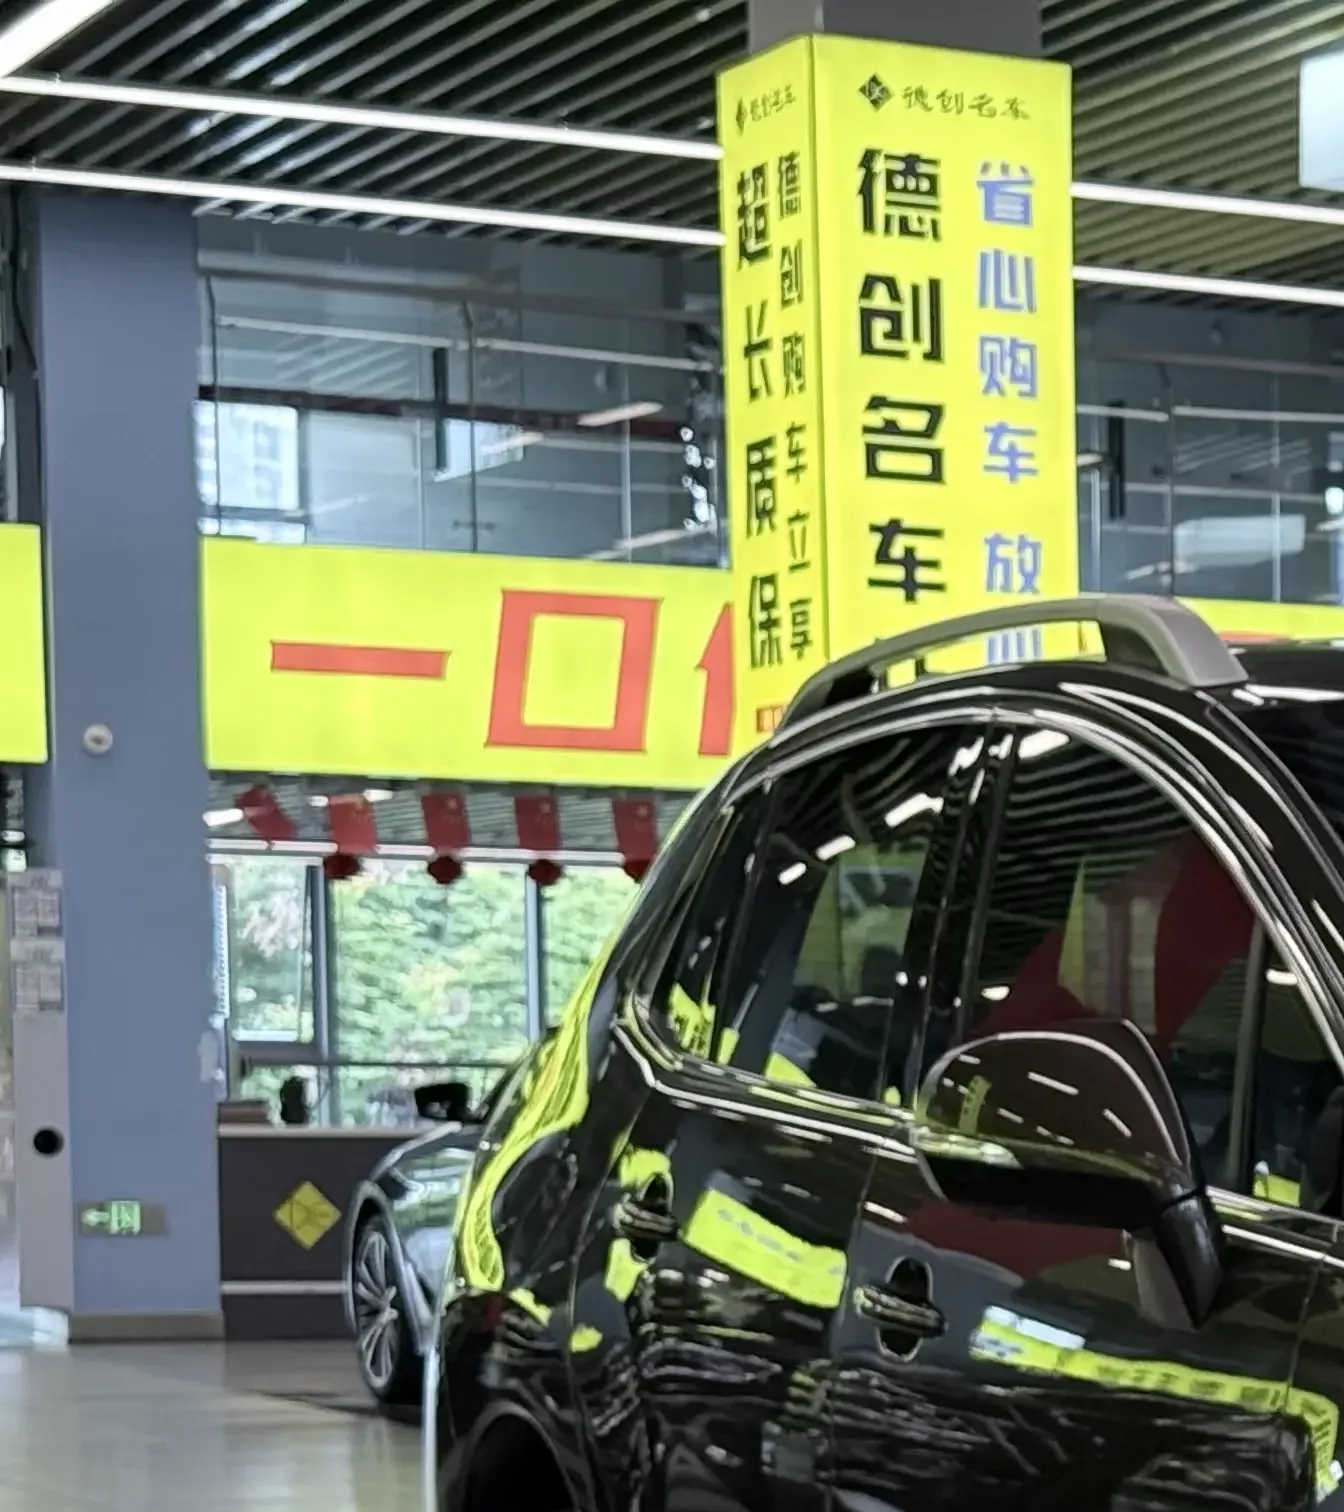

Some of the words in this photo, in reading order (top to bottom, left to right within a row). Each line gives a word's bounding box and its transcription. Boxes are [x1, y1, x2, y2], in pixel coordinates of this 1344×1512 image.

[736, 162, 784, 671] 超长质保
[777, 150, 814, 662] 德创购车立享
[856, 147, 948, 604] 德创名车
